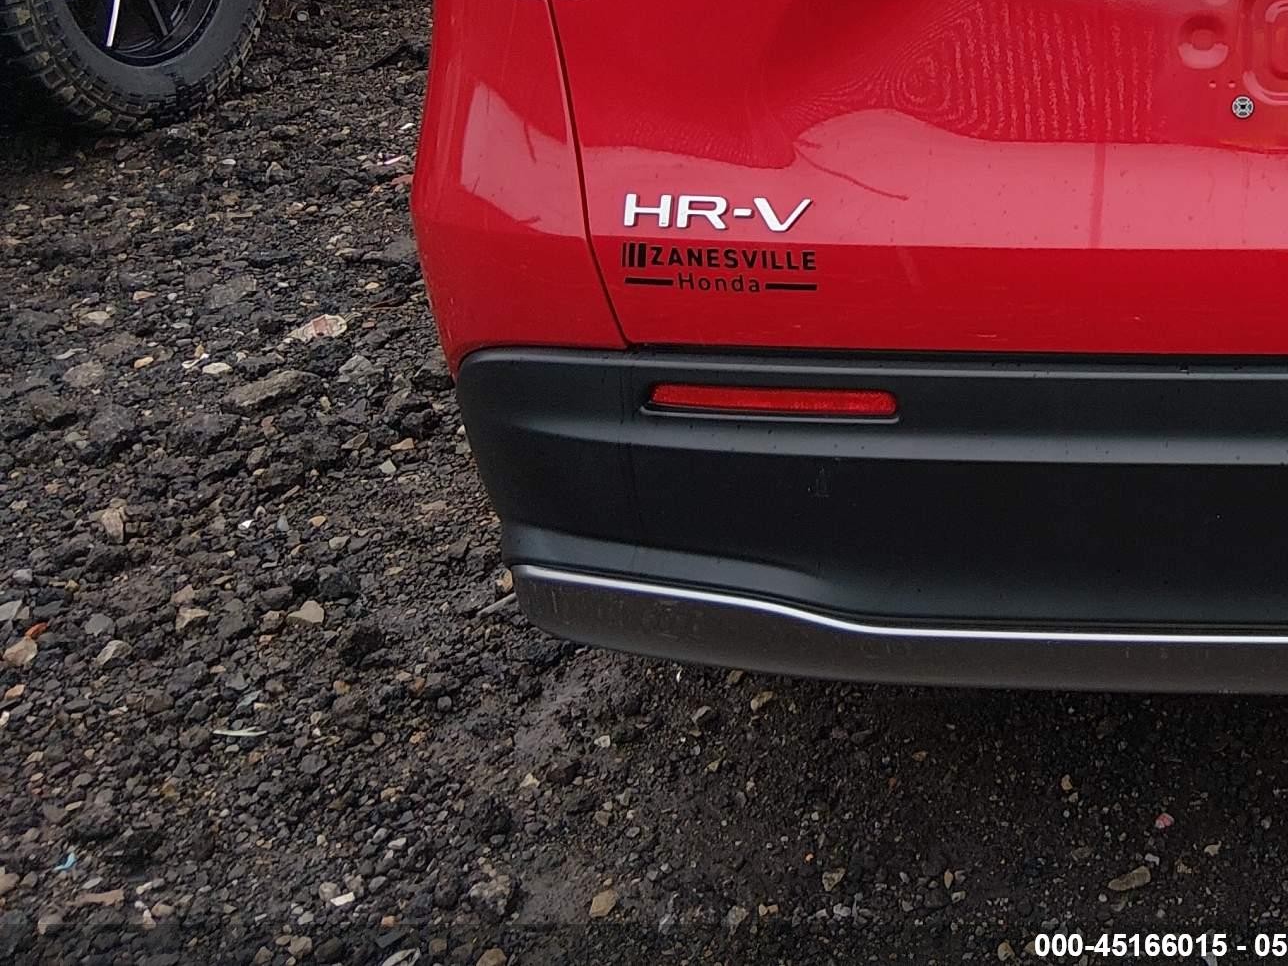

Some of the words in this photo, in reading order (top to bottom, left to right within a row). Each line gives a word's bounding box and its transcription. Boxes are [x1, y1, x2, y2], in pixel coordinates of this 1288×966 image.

[623, 193, 813, 232] HR-V
[650, 246, 816, 271] ZANESVILLE
[677, 272, 761, 292] Honda
